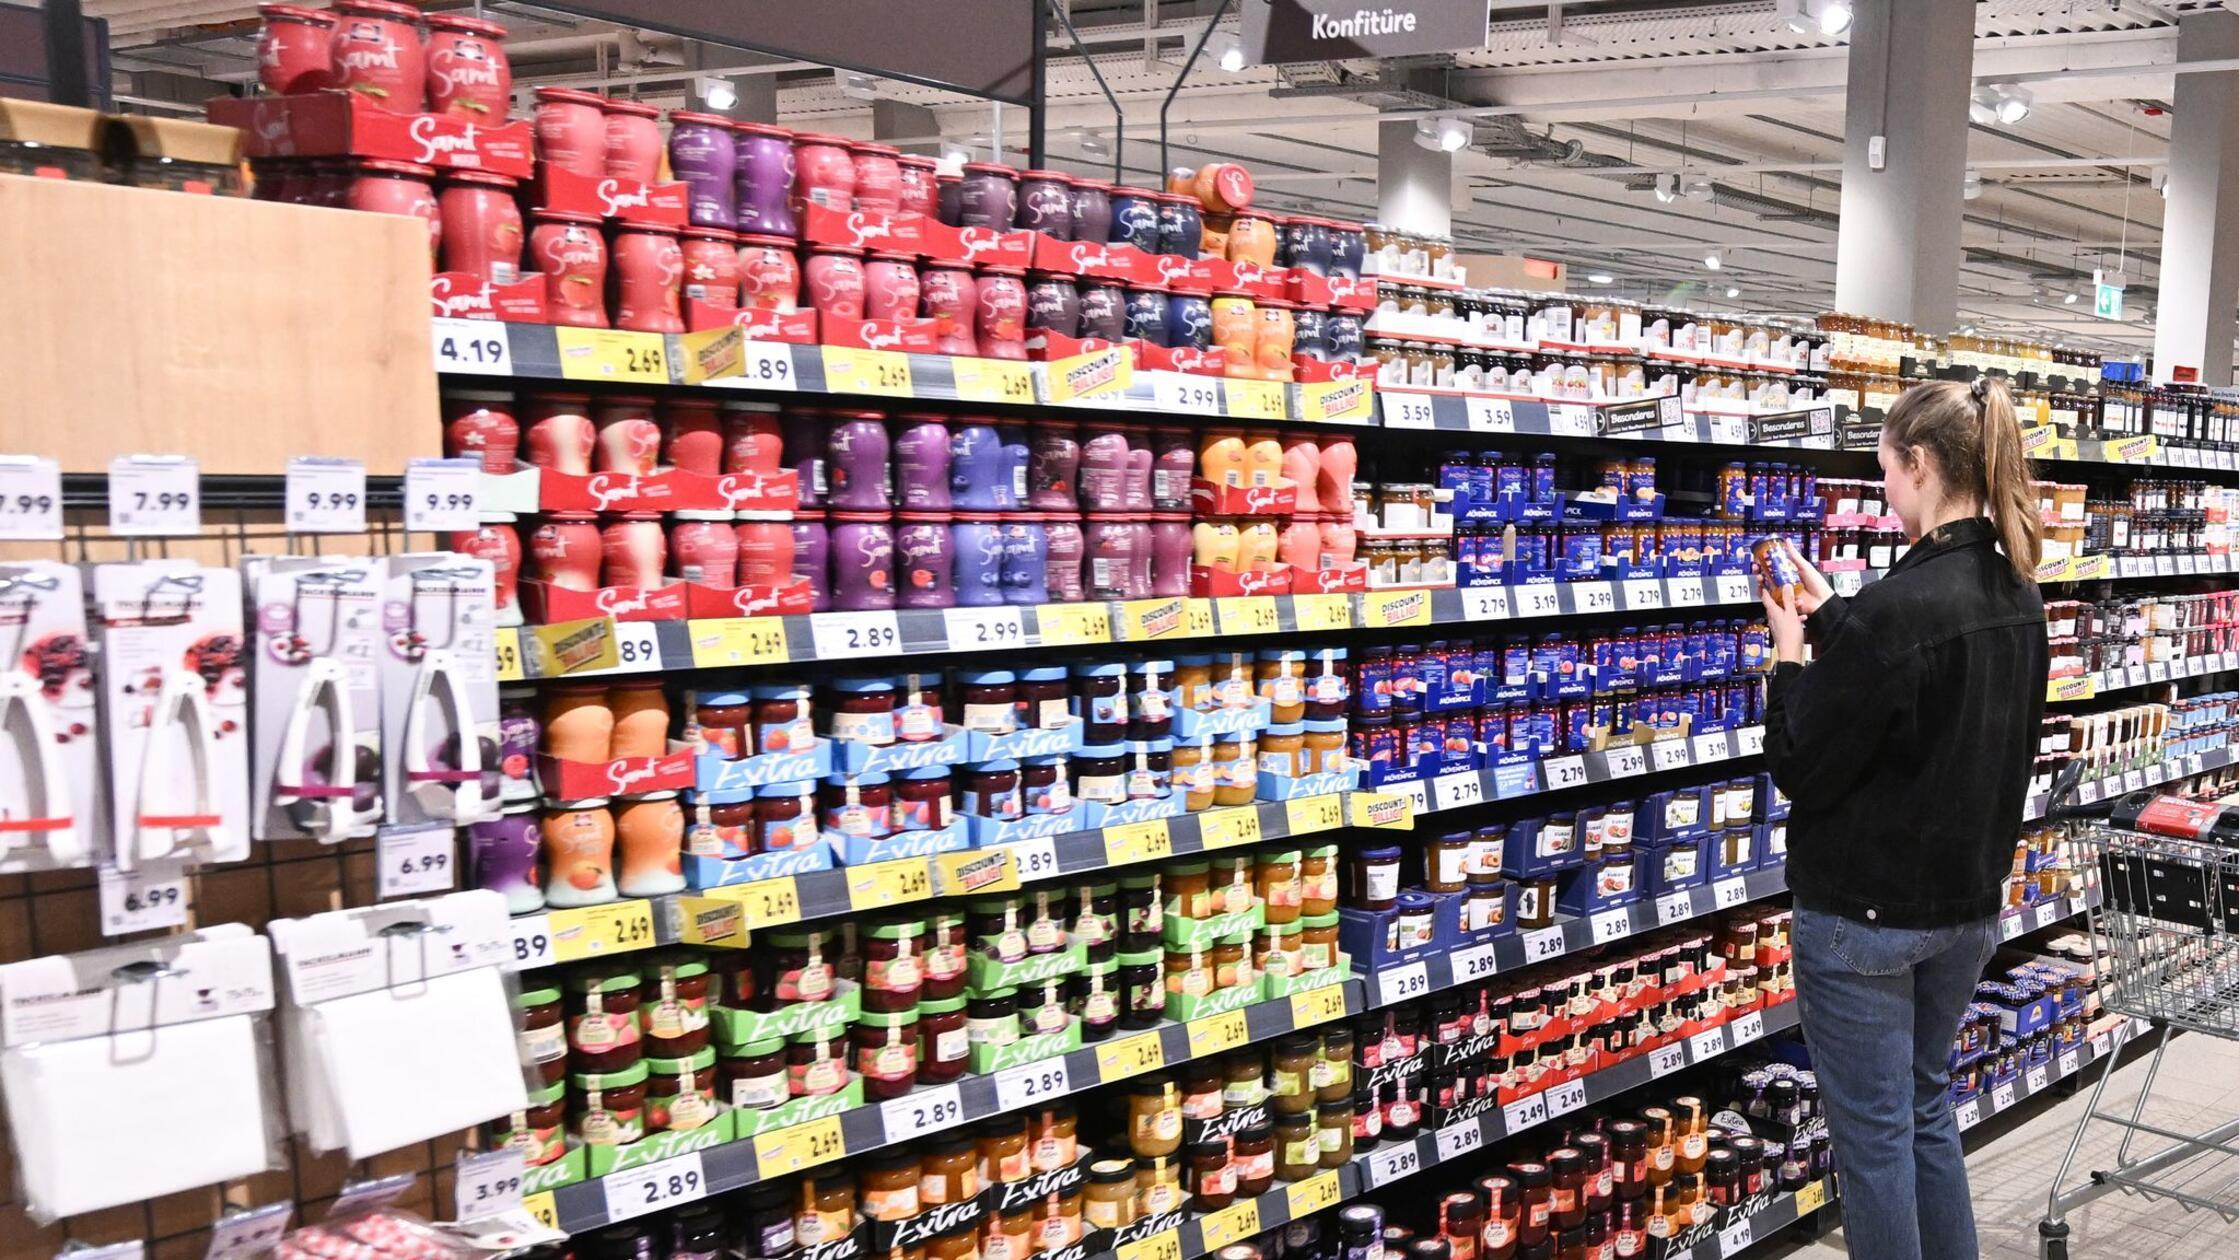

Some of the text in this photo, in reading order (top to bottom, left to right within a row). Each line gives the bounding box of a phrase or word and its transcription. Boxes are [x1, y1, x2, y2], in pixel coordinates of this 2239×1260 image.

[1312, 9, 1416, 40] Konfitüre
[410, 116, 483, 164] Samt
[597, 178, 650, 218] Samt
[846, 211, 893, 247] Samt
[1120, 205, 1158, 238] Samt
[959, 227, 1002, 261] Samt
[1071, 245, 1111, 275] Samt
[1158, 255, 1193, 285] Samt
[1233, 261, 1264, 290] Samt
[1328, 277, 1358, 304] Samt
[860, 322, 906, 349] Samt
[441, 337, 503, 363] 4.19
[626, 347, 661, 374] 2.69
[1172, 349, 1203, 373] Samt
[879, 364, 907, 387] 2.69
[1003, 375, 1029, 396] 2.69
[1178, 386, 1215, 407] 2.99
[1262, 394, 1284, 413] 2.69
[1402, 404, 1431, 421] 3.59
[1486, 409, 1511, 425] 3.59
[1611, 410, 1655, 424] Besonderes
[1762, 420, 1805, 433] Besonderes
[133, 491, 191, 512] 7.99
[308, 492, 358, 511] 9.99
[427, 493, 474, 512] 9.99
[588, 475, 643, 511] Samt
[718, 477, 768, 511] Samt
[1246, 487, 1279, 514] Samt
[1239, 572, 1271, 597] Samt
[1318, 571, 1346, 596] Samt
[1681, 588, 1702, 602] 2.79
[1729, 585, 1749, 599] 2.79
[596, 588, 650, 619] Samt
[734, 588, 783, 617] Samt
[1480, 599, 1506, 615] 2.79
[1534, 595, 1556, 610] 3.19
[1588, 592, 1612, 607] 2.99
[1639, 589, 1660, 604] 2.79
[1190, 611, 1210, 632] 2.69
[1255, 608, 1276, 628] 2.69
[1329, 605, 1347, 623] 2.69
[846, 627, 894, 649] 2.89
[976, 621, 1018, 642] 2.99
[1082, 616, 1106, 637] 2.69
[620, 639, 654, 664] 89
[1194, 709, 1264, 735] Extra
[983, 729, 1073, 760] Extra
[1708, 742, 1726, 757] 3.19
[1750, 735, 1764, 749] 3.1
[863, 742, 957, 773] Extra
[1621, 755, 1644, 772] 2.99
[1666, 749, 1687, 763] 2.99
[607, 758, 661, 796] Samt
[714, 751, 817, 790] Extra
[1560, 767, 1584, 783] 2.79
[1288, 773, 1352, 797] Extra
[1452, 783, 1479, 801] 2.79
[1102, 799, 1178, 826] Extra
[1320, 805, 1340, 824] 2.69
[992, 815, 1076, 845] Extra
[1236, 817, 1257, 837] 2.69
[866, 831, 959, 864] Extra
[1145, 832, 1167, 854] 2.69
[401, 853, 447, 875] 6.99
[718, 851, 822, 887] Extra
[1017, 852, 1052, 874] 2.89
[900, 870, 926, 895] 2.69
[1726, 888, 1745, 901] 2.89
[124, 886, 178, 912] 6.99
[1669, 902, 1690, 918] 2.89
[614, 916, 649, 942] 2.69
[1191, 910, 1259, 942] Extra
[1606, 919, 1628, 935] 2.89
[513, 935, 548, 960] 89
[1539, 937, 1563, 955] 2.89
[998, 952, 1079, 987] Extra
[1468, 955, 1494, 975] 2.89
[1284, 968, 1344, 996] Extra
[1398, 974, 1425, 995] 2.89
[1191, 988, 1259, 1021] Extra
[1325, 995, 1342, 1015] 2.69
[752, 1000, 849, 1042] Extra
[1225, 1022, 1245, 1042] 2.69
[1743, 1021, 1761, 1037] 2.49
[990, 1033, 1071, 1072] Extra
[1138, 1044, 1159, 1066] 2.69
[1444, 1034, 1496, 1066] Extra
[1703, 1037, 1722, 1054] 2.89
[1367, 1057, 1425, 1089] Extra
[1662, 1052, 1683, 1070] 2.89
[2066, 1058, 2078, 1070] 2.29
[1025, 1070, 1064, 1097] 2.89
[2034, 1075, 2046, 1088] 2.29
[1560, 1089, 1584, 1109] 2.49
[2000, 1092, 2014, 1106] 2.29
[755, 1093, 850, 1135] Extra
[913, 1100, 957, 1128] 2.89
[1443, 1096, 1494, 1127] Extra
[1519, 1103, 1544, 1124] 2.49
[1720, 1113, 1745, 1128] Extra
[1965, 1109, 1978, 1122] 2.29
[1199, 1106, 1267, 1143] Extra
[1793, 1116, 1827, 1142] Extra
[610, 1128, 721, 1173] Extra
[810, 1130, 839, 1157] 2.69
[1453, 1129, 1480, 1150] 2.89
[1388, 1153, 1416, 1175] 2.89
[475, 1176, 520, 1201] 3.99
[643, 1170, 699, 1204] 2.89
[999, 1166, 1082, 1209] Extra
[1320, 1180, 1337, 1202] 2.69
[1812, 1188, 1824, 1204] 2.69
[1237, 1209, 1257, 1233] 2.69
[1726, 1192, 1771, 1227] Extra
[890, 1200, 981, 1248] Extra
[1111, 1212, 1185, 1250] Extra
[1664, 1222, 1715, 1259] Extra
[1732, 1227, 1751, 1246] 4.19
